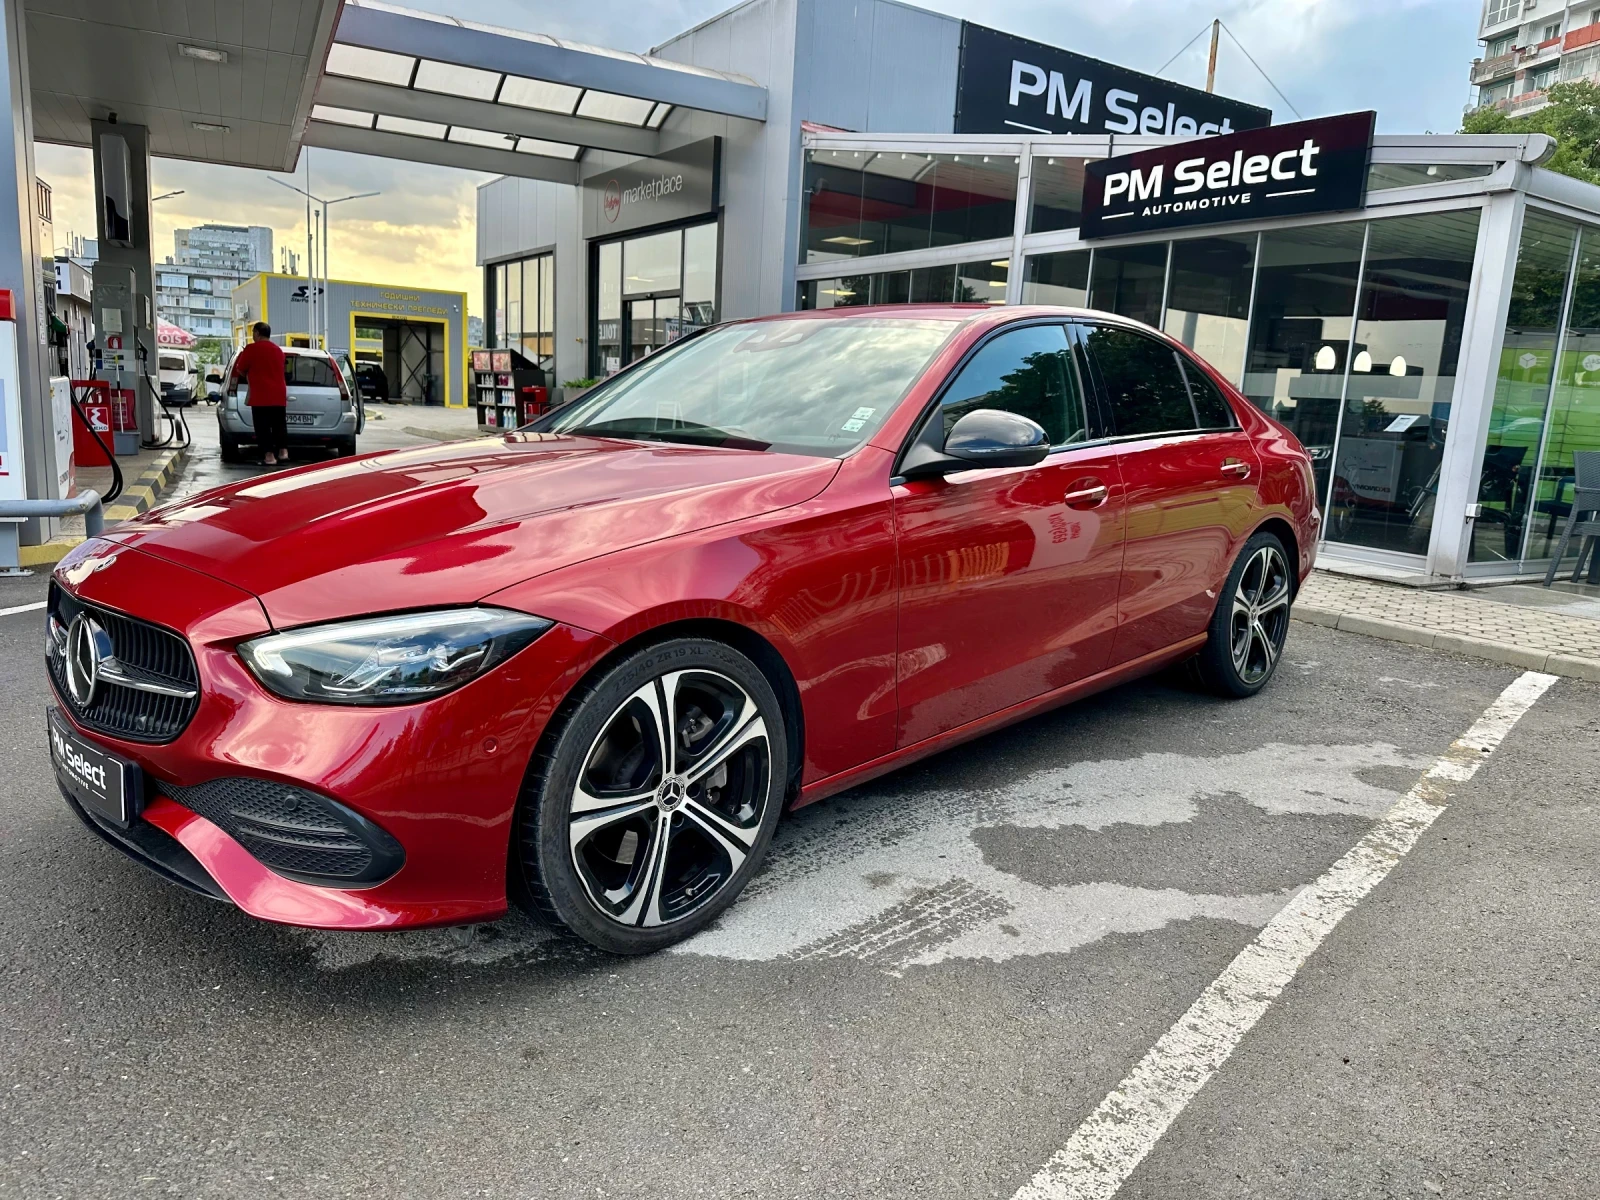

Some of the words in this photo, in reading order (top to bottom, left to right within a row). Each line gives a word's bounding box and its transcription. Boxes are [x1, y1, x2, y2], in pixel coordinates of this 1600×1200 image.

[1008, 59, 1093, 124] PM
[1102, 164, 1162, 207] PM
[1173, 139, 1321, 195] Select
[623, 174, 683, 204] marketplace
[1142, 192, 1252, 217] AUTOMOTIVE
[350, 300, 405, 311] ТЕХНИЧЕСКИ
[408, 305, 448, 315] ПРЕГЛЕДИ
[380, 292, 420, 302] ГОДИШНИ
[157, 334, 182, 344] OIS
[614, 659, 654, 693] 225/40
[656, 651, 672, 663] ZR
[674, 647, 687, 658] 19
[689, 647, 704, 656] XL
[52, 726, 65, 759] PM
[65, 743, 107, 791] Select
